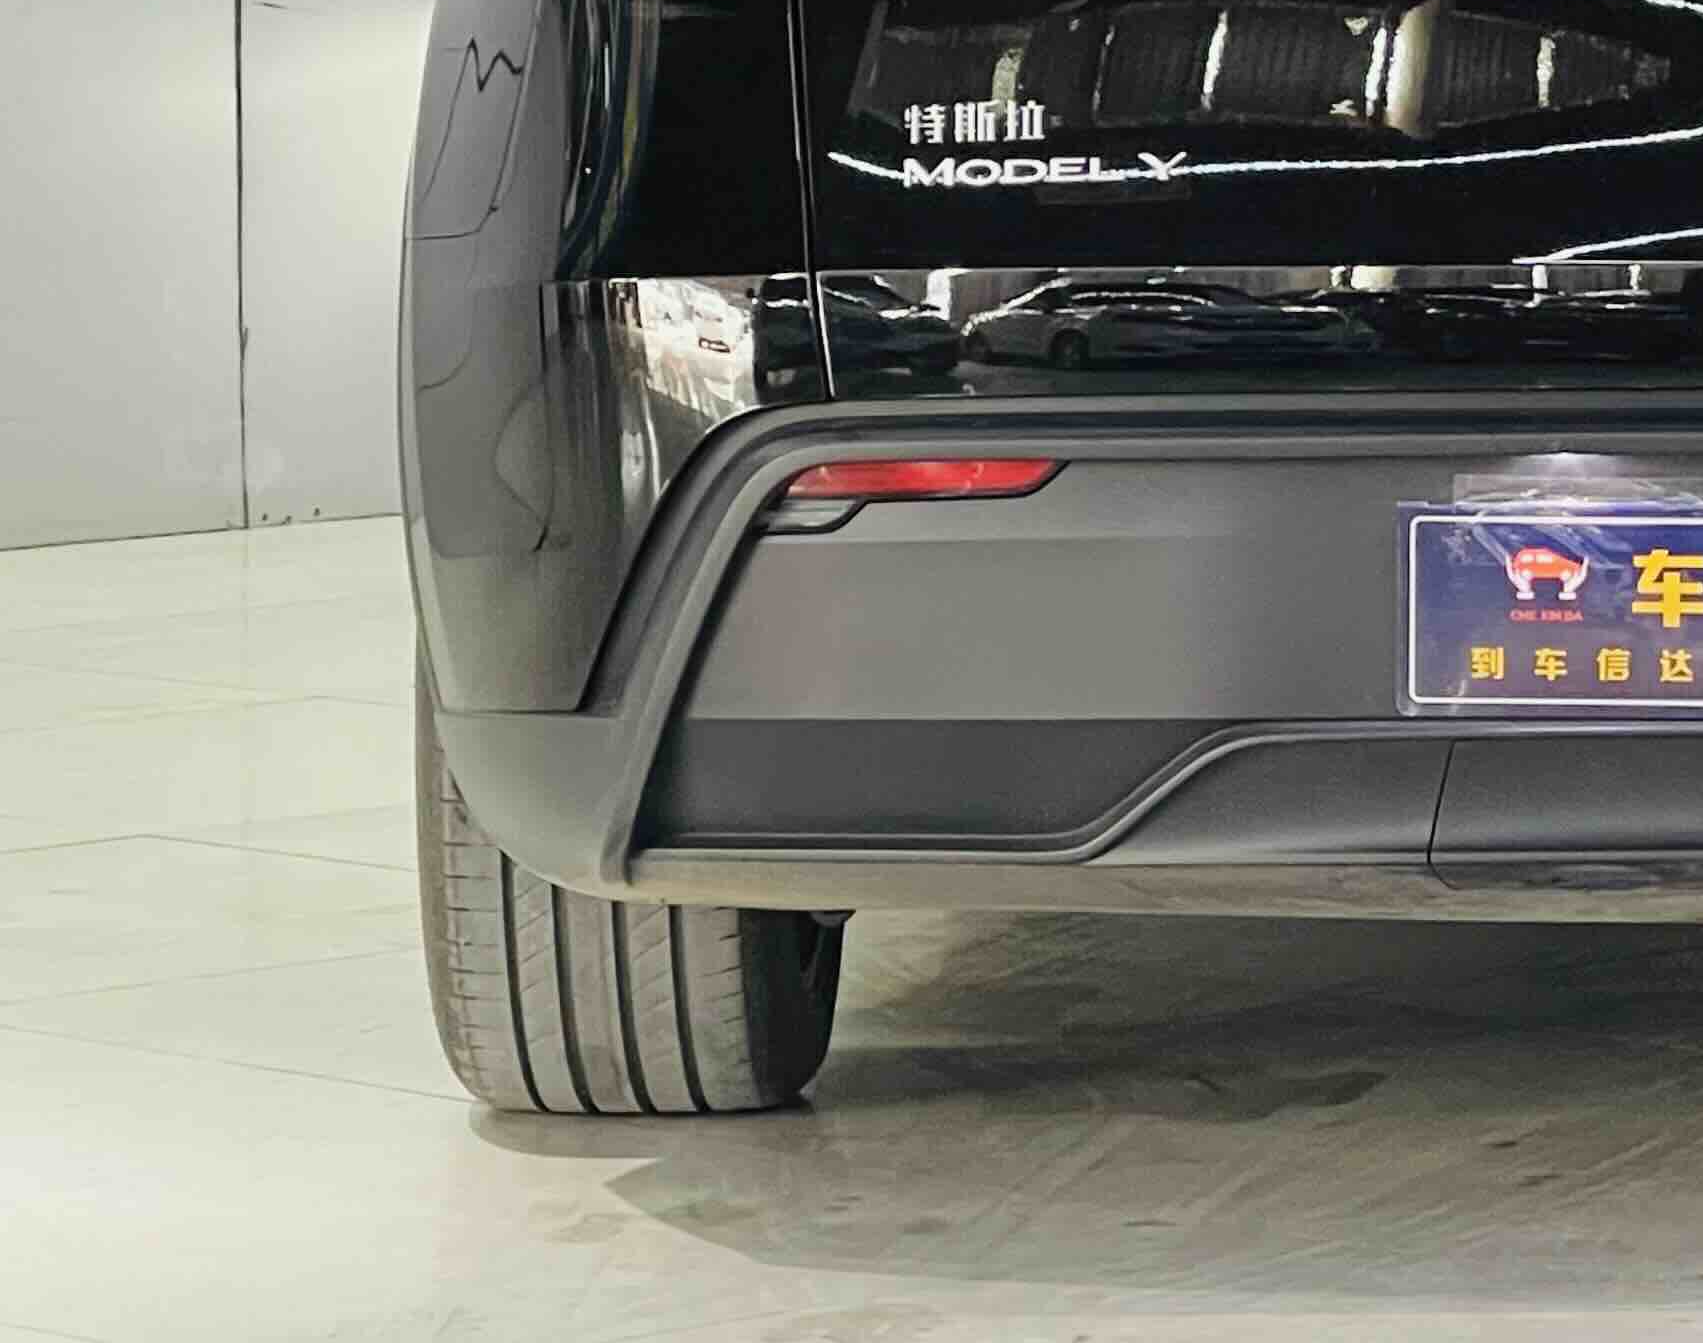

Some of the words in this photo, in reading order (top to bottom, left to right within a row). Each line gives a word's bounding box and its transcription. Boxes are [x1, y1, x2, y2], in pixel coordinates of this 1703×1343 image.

[904, 100, 1046, 144] 特斯拉
[902, 156, 1125, 188] MODEL
[1137, 152, 1187, 181] Y
[1470, 646, 1695, 683] 到车信达
